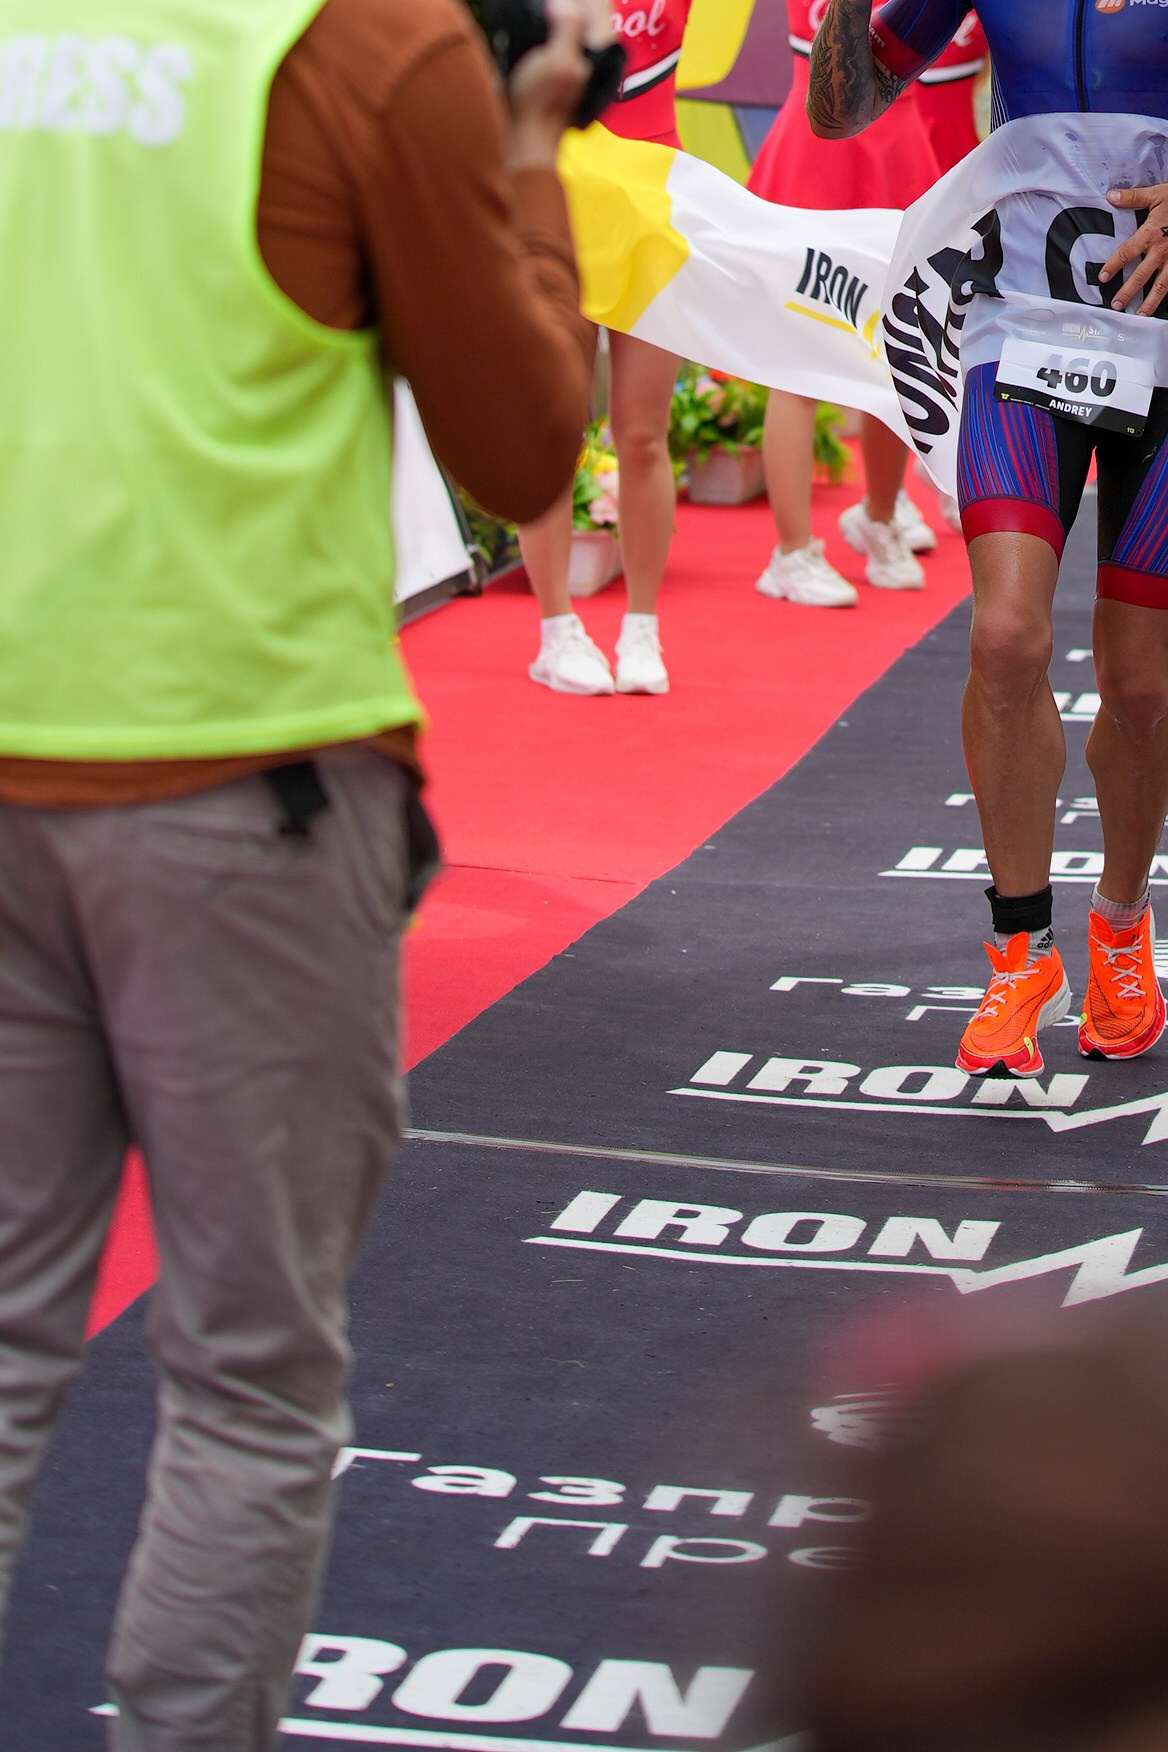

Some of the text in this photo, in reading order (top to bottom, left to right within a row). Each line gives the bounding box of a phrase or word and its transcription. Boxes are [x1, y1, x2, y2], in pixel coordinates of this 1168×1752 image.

[1036, 353, 1118, 398] 460
[1049, 399, 1093, 418] ANDREY
[690, 1051, 1090, 1108] IRON
[549, 1190, 1002, 1261] IRON
[292, 1632, 756, 1739] RON
